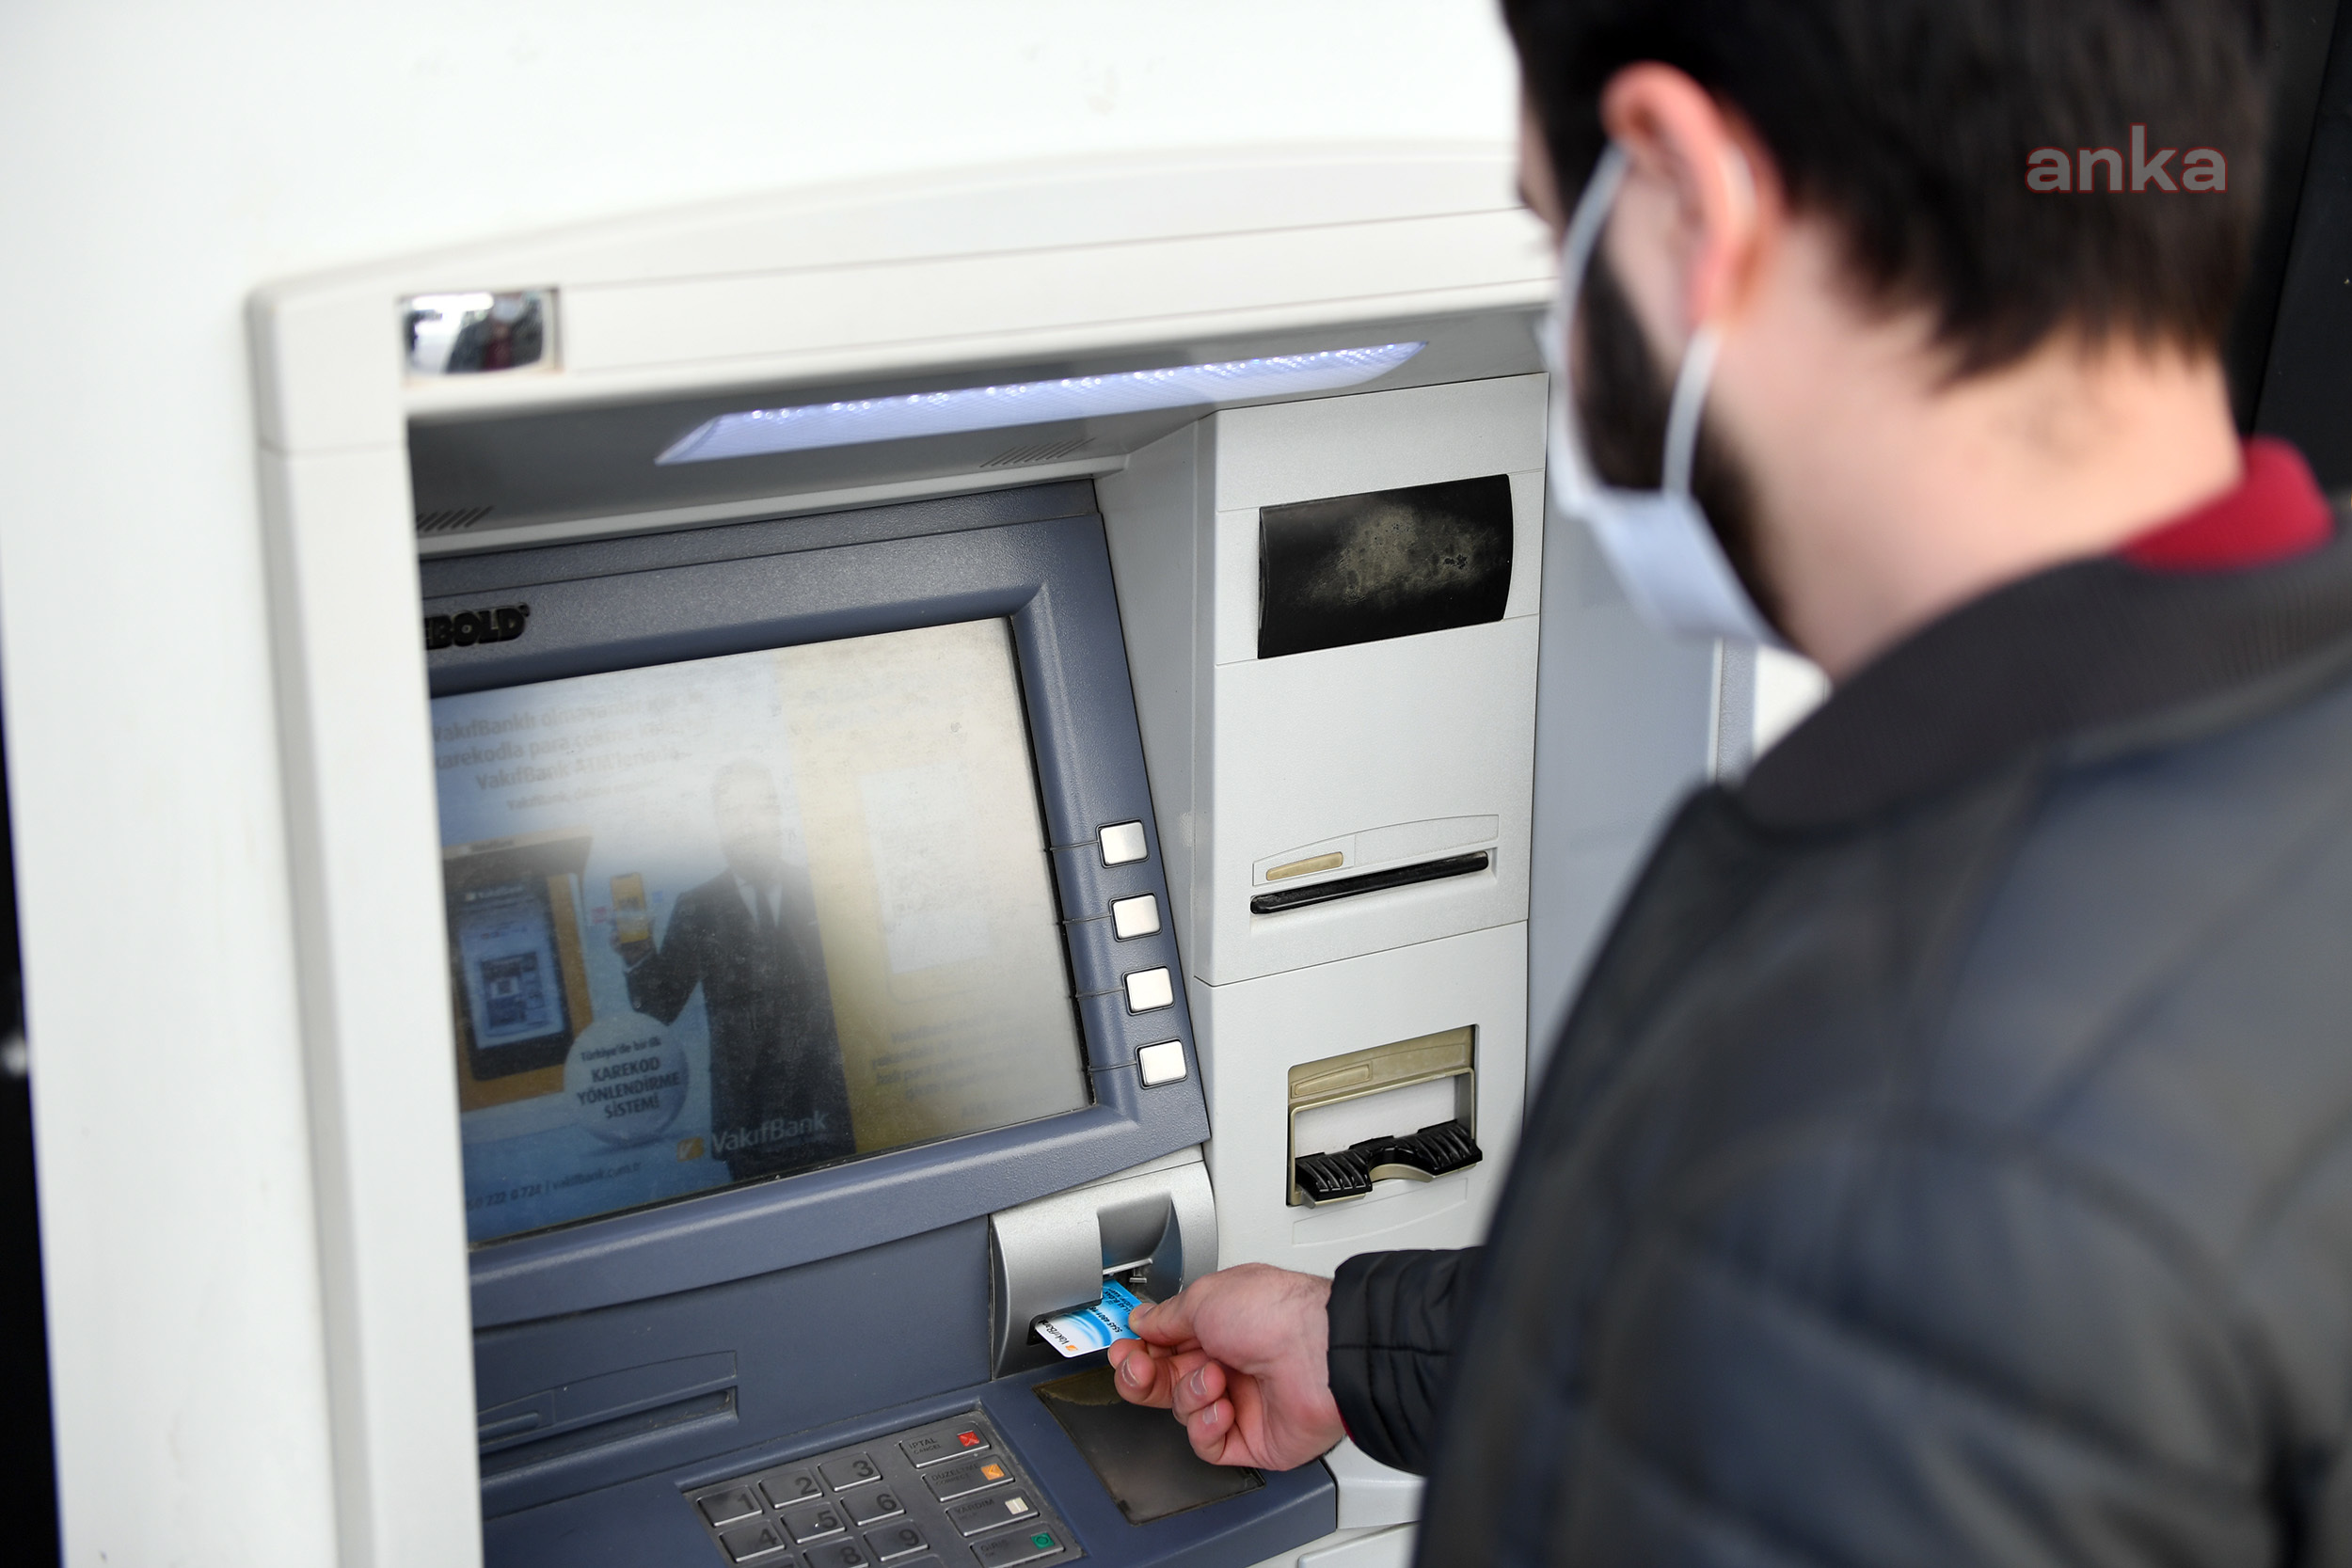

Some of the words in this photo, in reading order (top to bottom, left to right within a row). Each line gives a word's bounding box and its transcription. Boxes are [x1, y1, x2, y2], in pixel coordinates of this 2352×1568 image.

[591, 1055, 661, 1083] KAREKOD
[576, 1070, 680, 1106] YÖNLENDİRME
[852, 1459, 874, 1478] 3
[794, 1477, 818, 1496] 2
[738, 1493, 755, 1511] 1
[876, 1493, 898, 1512] 6
[817, 1510, 838, 1529] 5
[758, 1528, 777, 1546] 4
[898, 1528, 919, 1547] 9
[839, 1545, 862, 1565] 8
